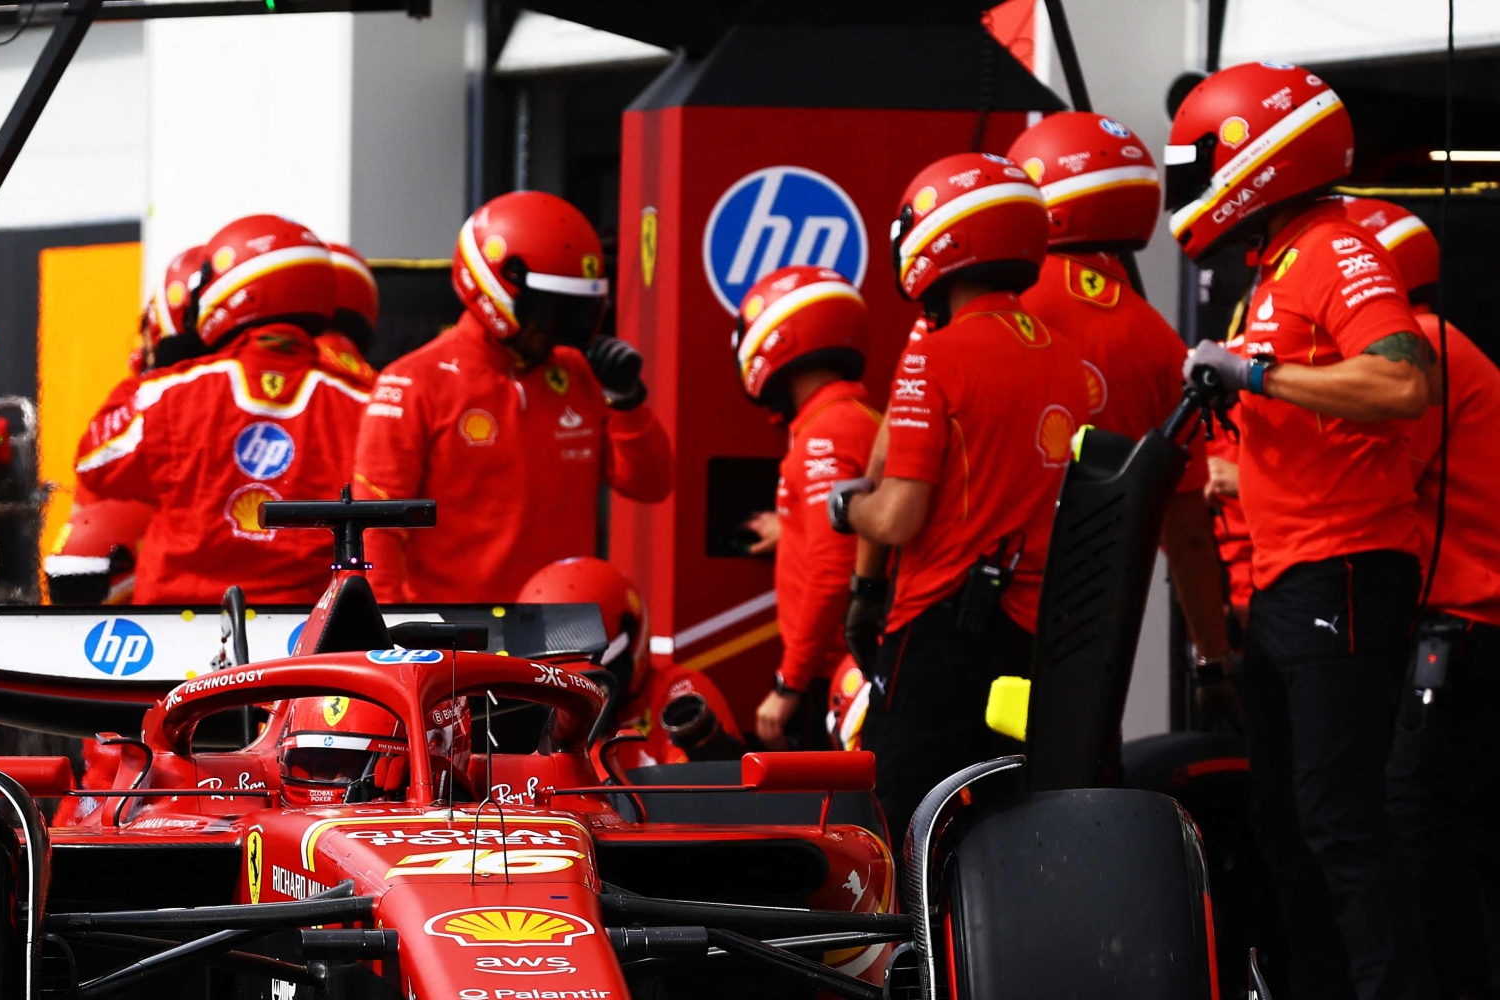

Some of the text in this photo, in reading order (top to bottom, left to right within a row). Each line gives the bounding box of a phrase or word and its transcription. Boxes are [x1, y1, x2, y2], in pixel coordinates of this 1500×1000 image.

[241, 425, 290, 478] hp
[88, 618, 152, 676] hp
[185, 669, 266, 694] TECHNOLOGY
[530, 662, 568, 688] DXC
[309, 789, 334, 797] GLOBAL
[345, 829, 580, 840] GLOBAL
[369, 836, 567, 846] POKER
[383, 849, 586, 880] 16
[273, 864, 306, 900] RICHARD
[475, 956, 572, 969] aws
[493, 988, 611, 1000] Palantir
